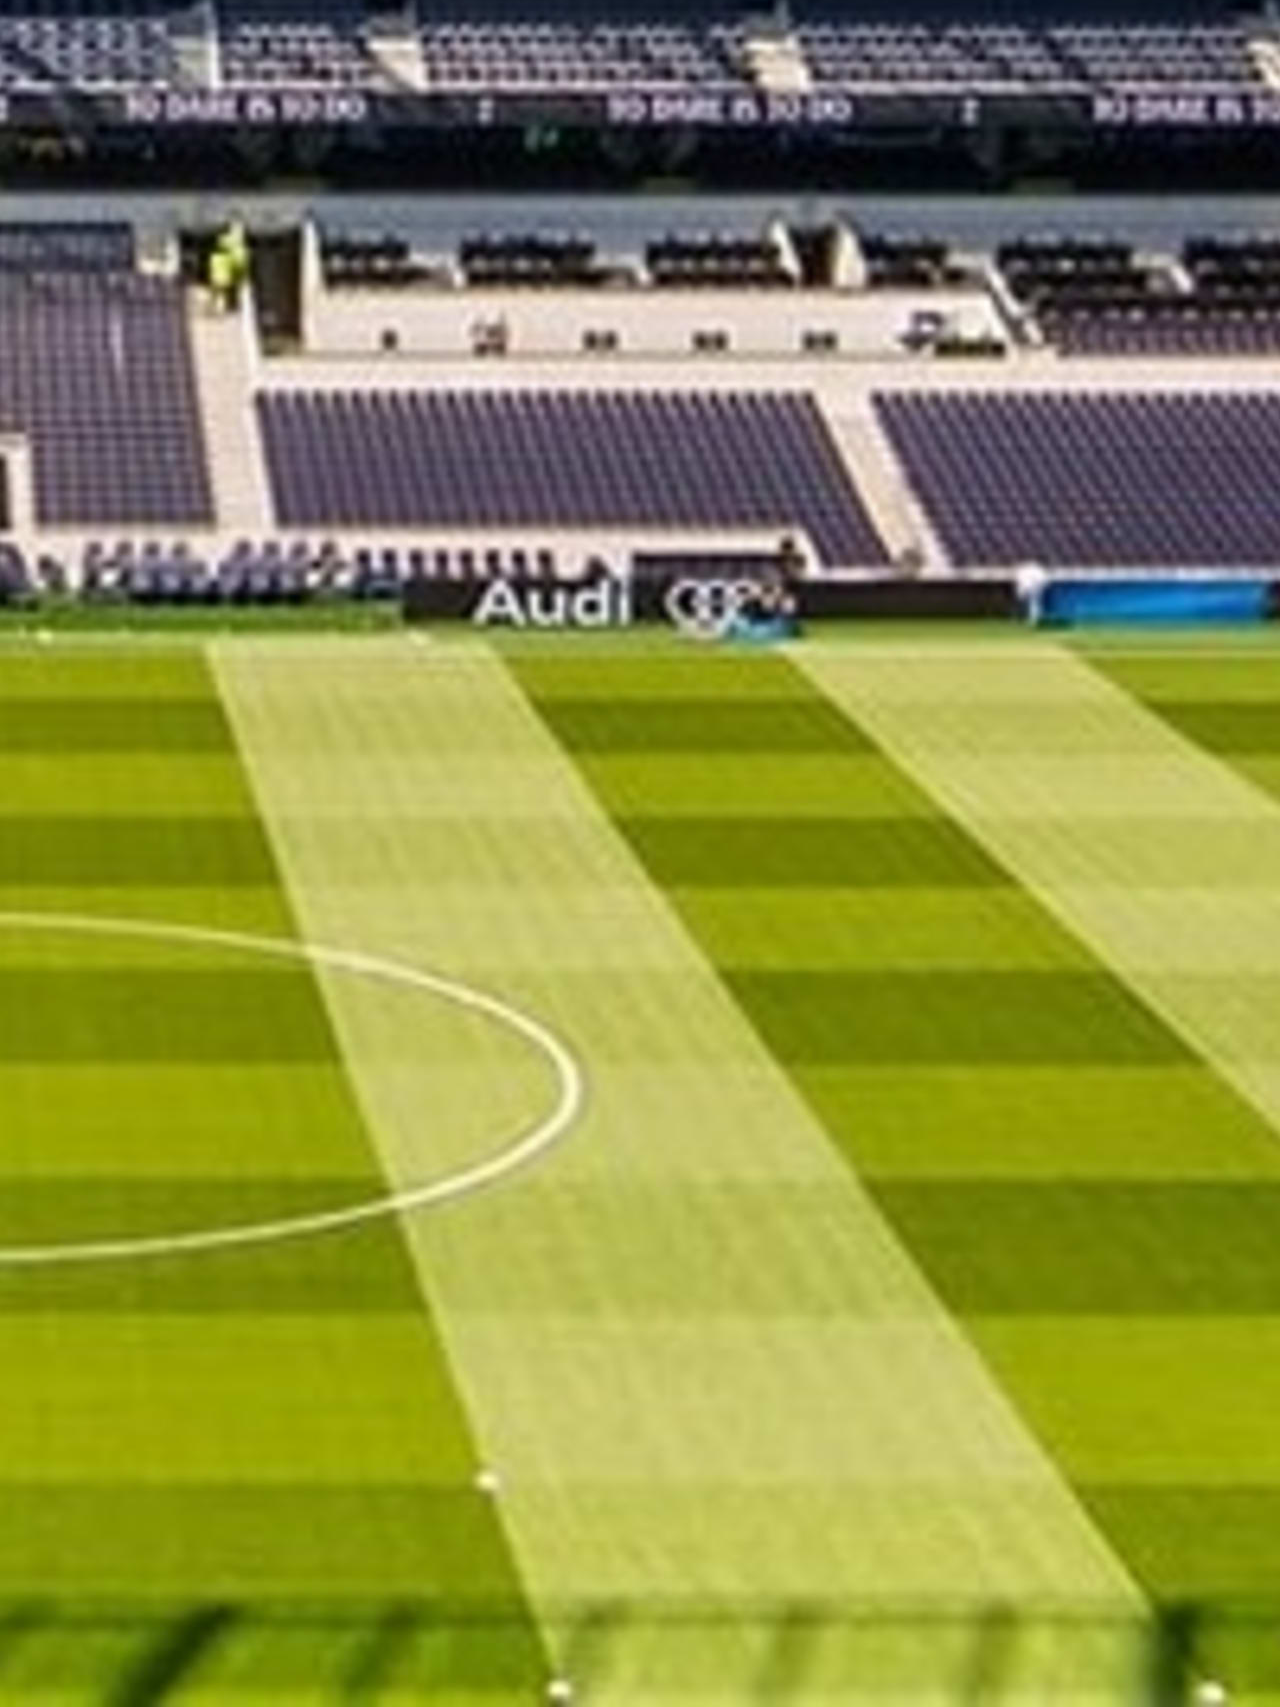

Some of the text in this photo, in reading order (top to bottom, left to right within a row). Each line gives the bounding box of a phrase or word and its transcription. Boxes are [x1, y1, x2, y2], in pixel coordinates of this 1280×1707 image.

[127, 92, 161, 121] TO
[281, 92, 318, 121] TO
[323, 92, 367, 121] DO
[609, 96, 647, 123] TO
[766, 96, 801, 123] TO
[807, 96, 852, 123] DO
[1093, 96, 1128, 123] TO
[472, 579, 630, 626] Audi
